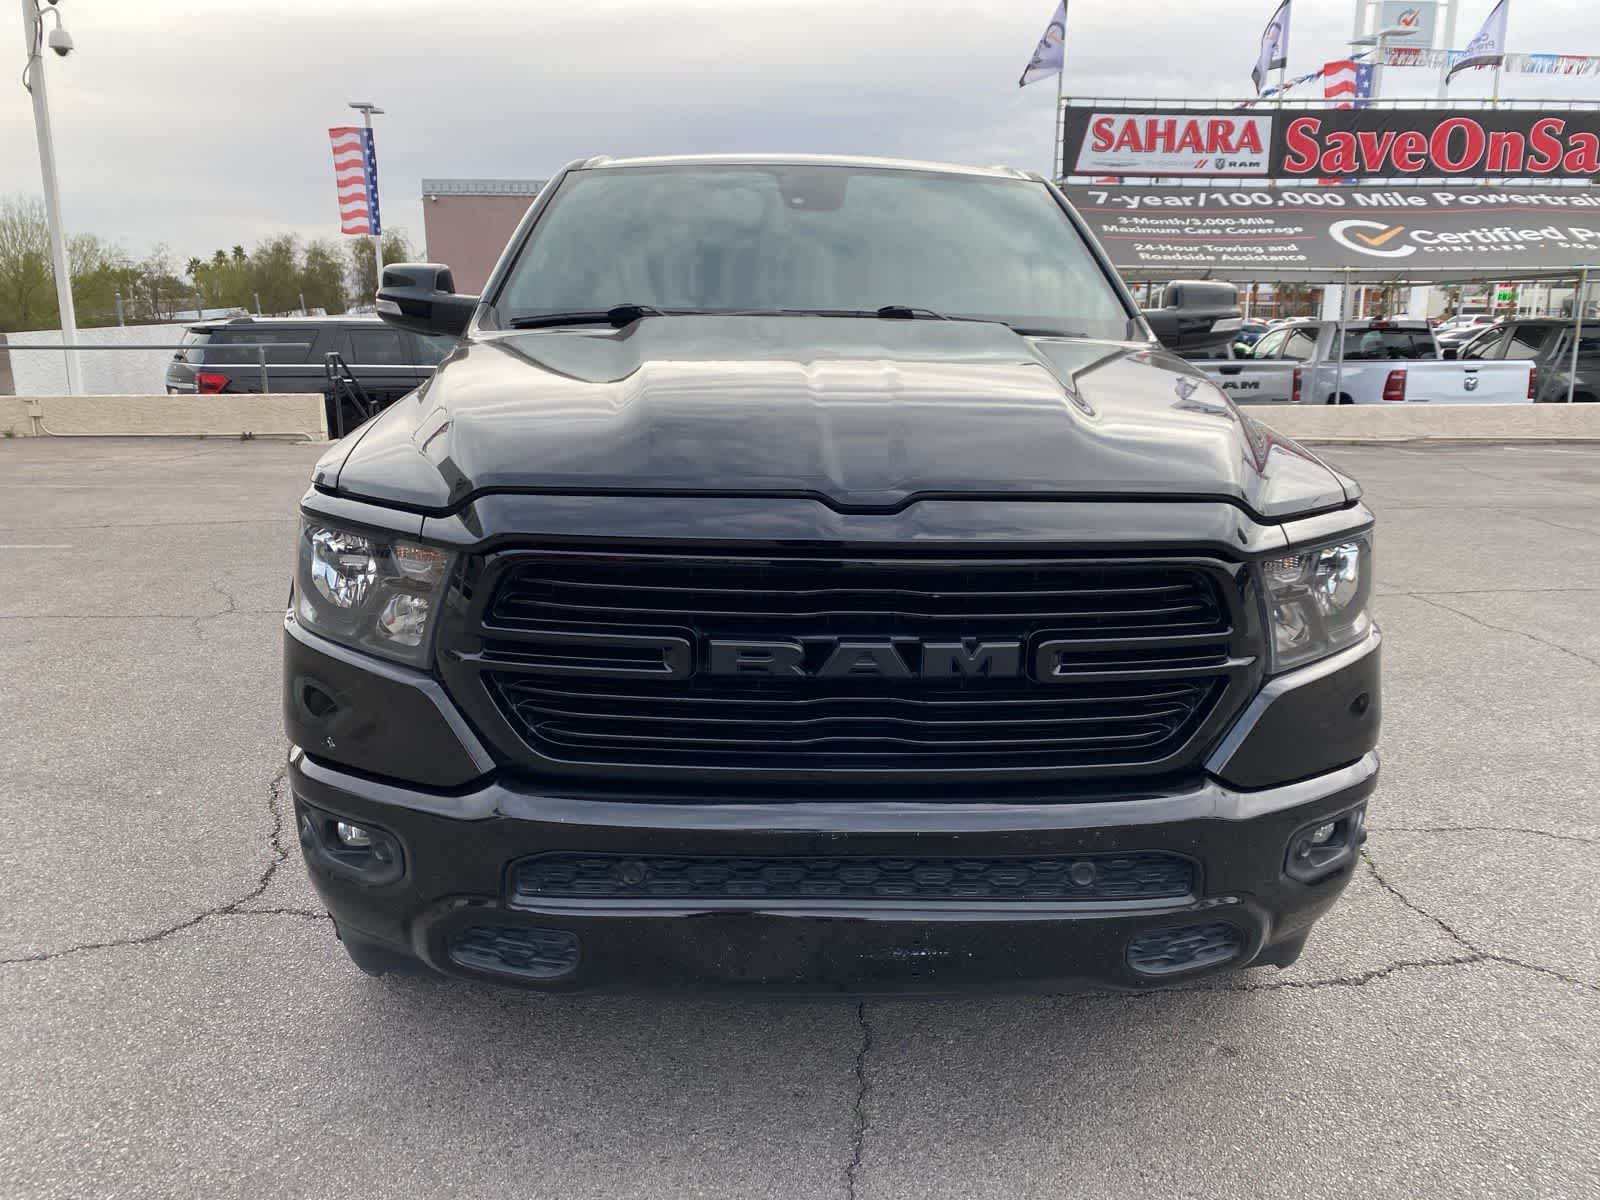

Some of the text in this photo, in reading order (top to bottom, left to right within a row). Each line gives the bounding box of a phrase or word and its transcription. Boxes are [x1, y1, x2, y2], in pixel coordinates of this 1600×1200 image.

[1092, 117, 1264, 154] SAHARA
[1284, 117, 1600, 173] SaveOnSa
[1088, 191, 1345, 208] 7-year/100,000
[1352, 191, 1427, 206] Mile
[1102, 224, 1181, 234] Maximum
[1225, 226, 1304, 235] Coverage
[1409, 225, 1568, 244] Certified
[1133, 243, 1299, 254] 24-Hour Towing and
[1424, 244, 1528, 252] CHRYSLER
[1138, 252, 1307, 261] Roadside Assistance
[1222, 381, 1260, 389] AM
[709, 637, 1021, 678] RAM
